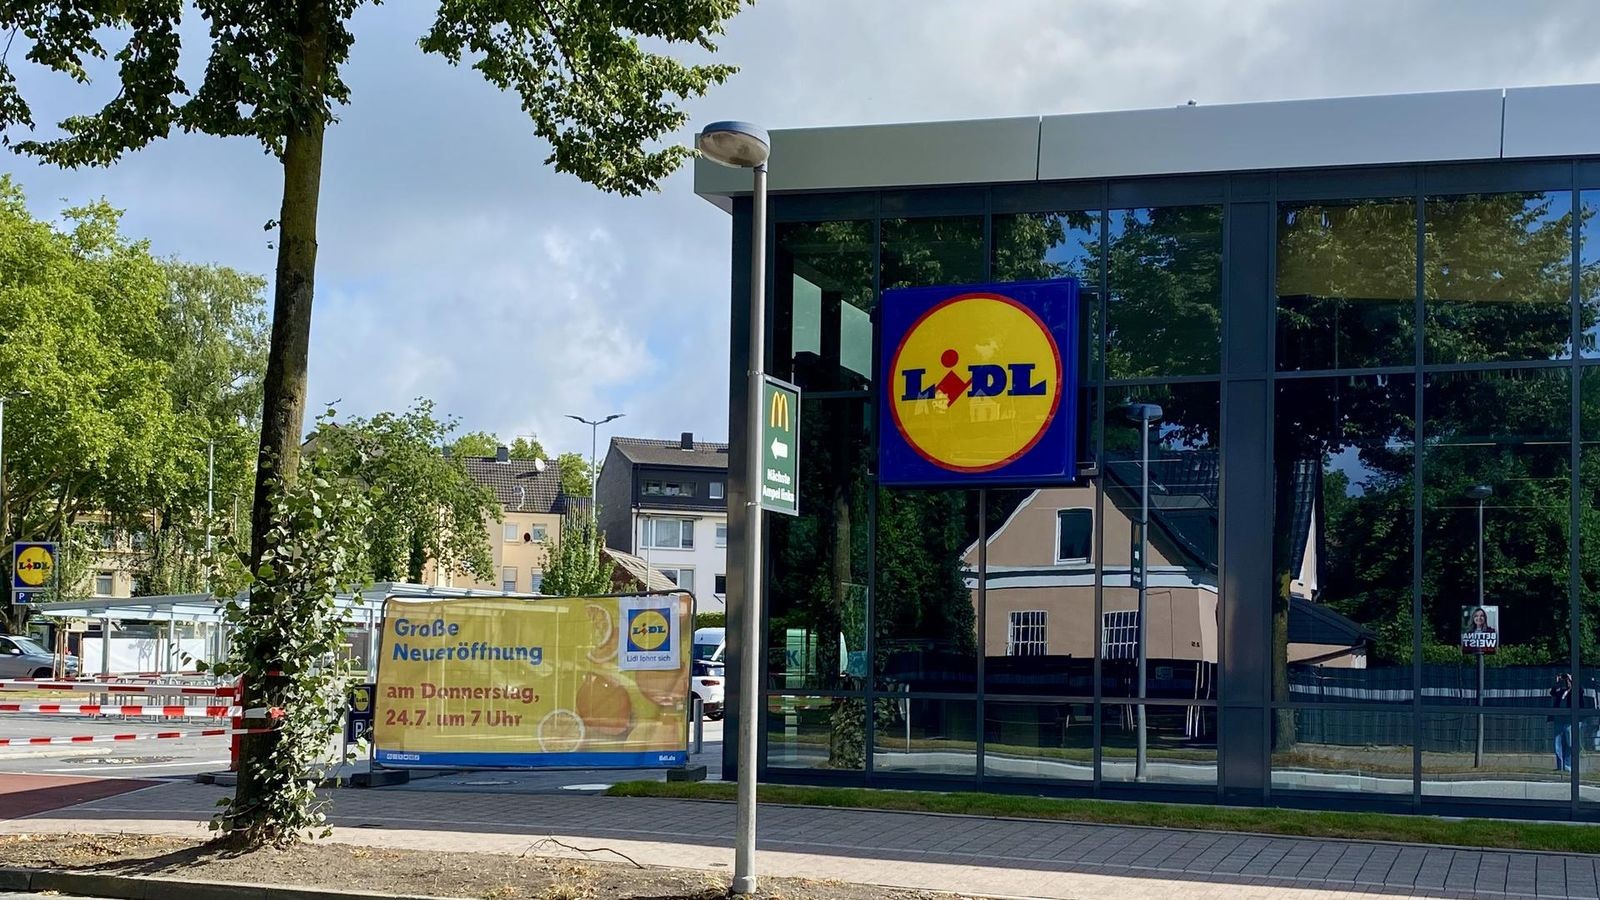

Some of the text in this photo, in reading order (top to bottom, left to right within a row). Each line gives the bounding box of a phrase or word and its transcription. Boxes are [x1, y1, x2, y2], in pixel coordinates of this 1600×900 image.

[394, 618, 459, 637] Große
[392, 641, 543, 665] Neueröffnung
[386, 683, 540, 703] am Donnerstag,
[385, 709, 523, 727] 24.7. um 7 Uhr
[355, 722, 363, 738] P
